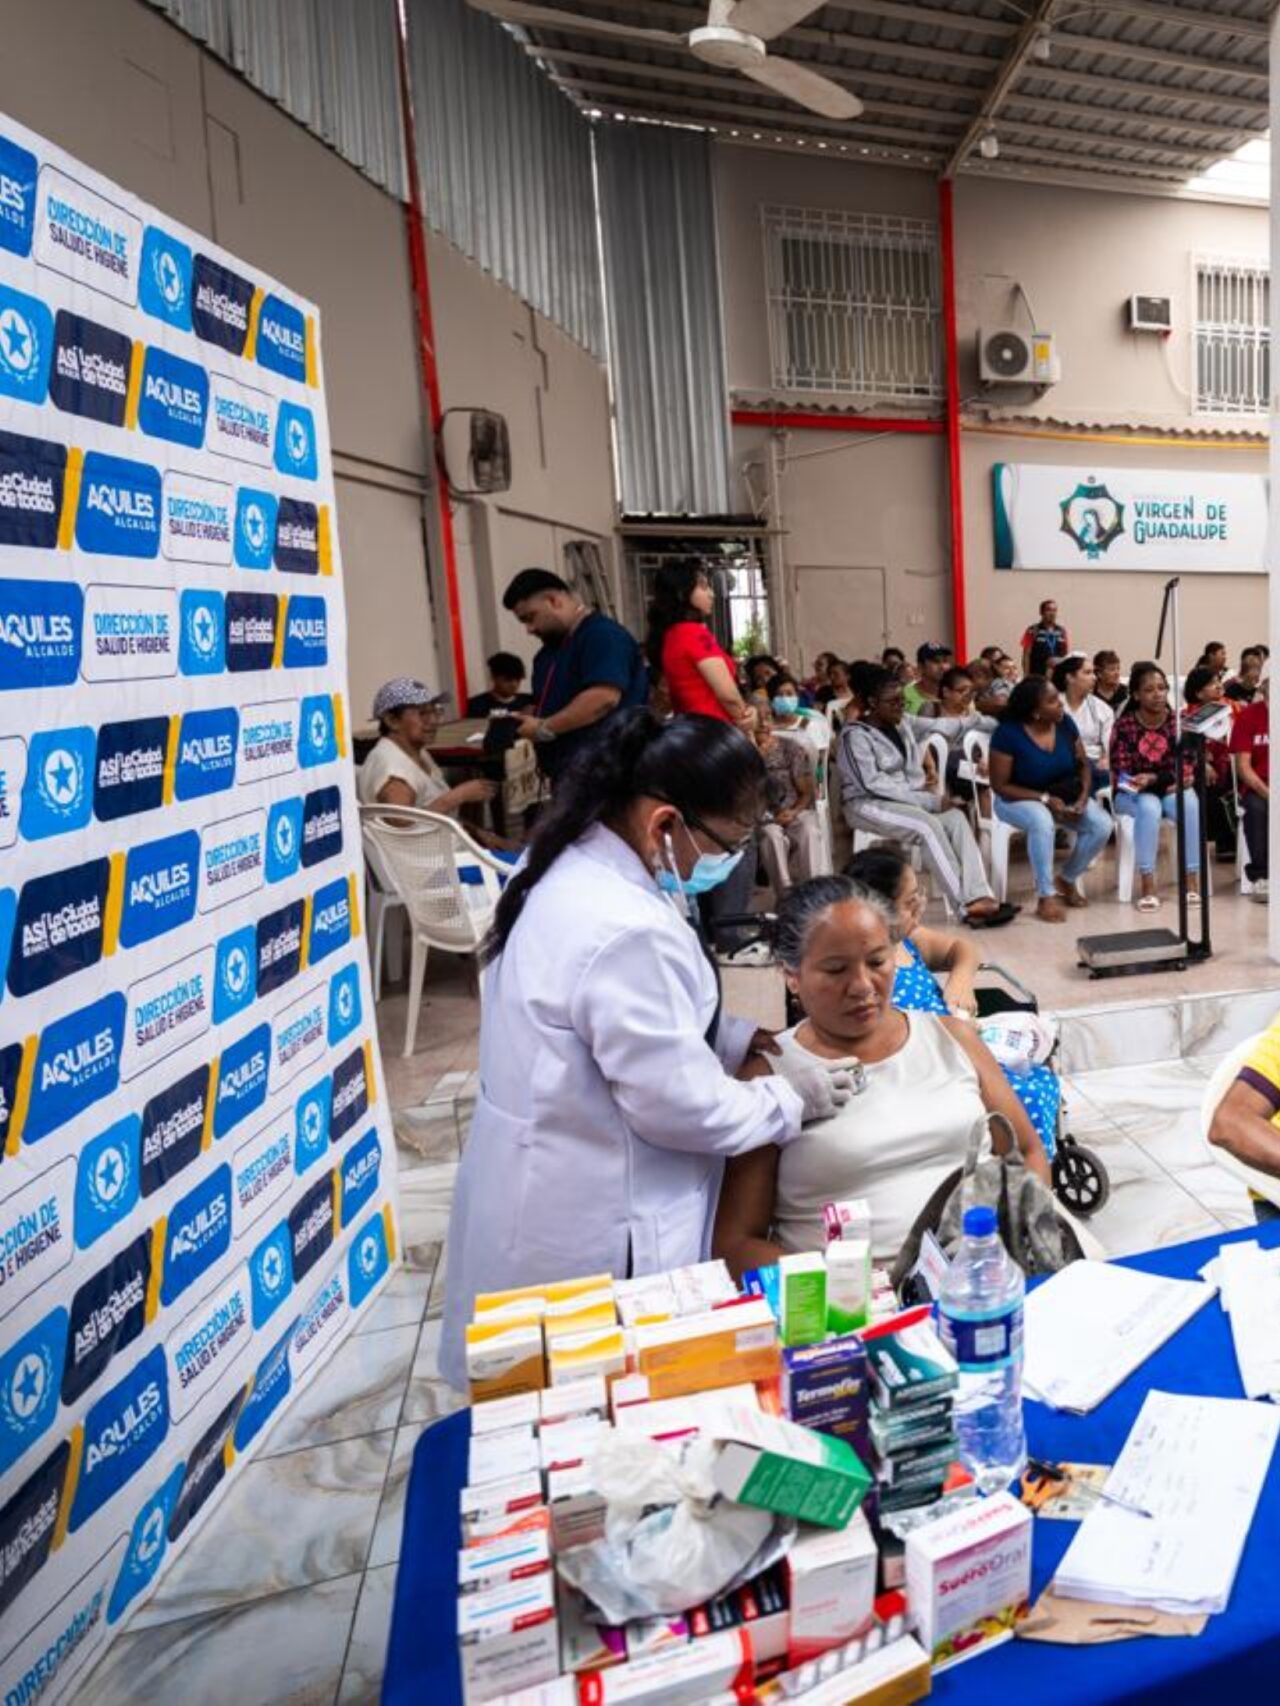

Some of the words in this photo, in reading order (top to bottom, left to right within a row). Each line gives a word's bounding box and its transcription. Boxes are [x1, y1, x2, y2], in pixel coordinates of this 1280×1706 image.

[48, 195, 113, 249] DIRECCIÓN
[113, 232, 127, 257] DE
[50, 222, 85, 255] SALUD
[86, 240, 93, 260] E
[94, 244, 129, 279] HIGIENE
[263, 317, 305, 353] AQUILES
[145, 374, 201, 414] AQUILES
[10, 470, 54, 497] Ciudad
[87, 482, 155, 518] AQUILES
[114, 515, 157, 533] ALCALDE
[1134, 494, 1194, 519] VIRGEN
[1206, 504, 1227, 520] DE
[1133, 520, 1228, 544] GUADALUPE
[93, 608, 155, 636] DIRECCIÓN
[156, 613, 170, 635] DE
[288, 617, 325, 641] AQUILES
[26, 644, 75, 659] ALCALDE
[96, 636, 128, 656] SALUD
[129, 638, 136, 655] E
[136, 636, 171, 655] HIGIENE
[181, 734, 233, 765] AQUILES
[130, 862, 191, 907] AQUILES
[154, 885, 192, 910] ALCALDE
[60, 895, 100, 924] Ciudad
[67, 914, 101, 939] todos
[135, 980, 190, 1028] DIRECCIÓN
[189, 973, 203, 996] DE
[136, 1016, 168, 1047] SALUD
[168, 1011, 175, 1029] E
[175, 993, 206, 1024] HIGIENE
[41, 1026, 115, 1092] AQUILES
[72, 1052, 116, 1088] ALCALDE
[219, 1051, 267, 1104] AQUILES
[38, 1196, 58, 1229] DE
[171, 1193, 227, 1263] AQUILES
[6, 1255, 15, 1278] E
[15, 1221, 62, 1272] HIGIENE
[175, 1306, 230, 1373] DIRECCIÓN
[229, 1289, 244, 1319] DE
[179, 1353, 211, 1390] SALUD
[216, 1313, 246, 1350] HIGIENE
[86, 1380, 161, 1475] AQUILES
